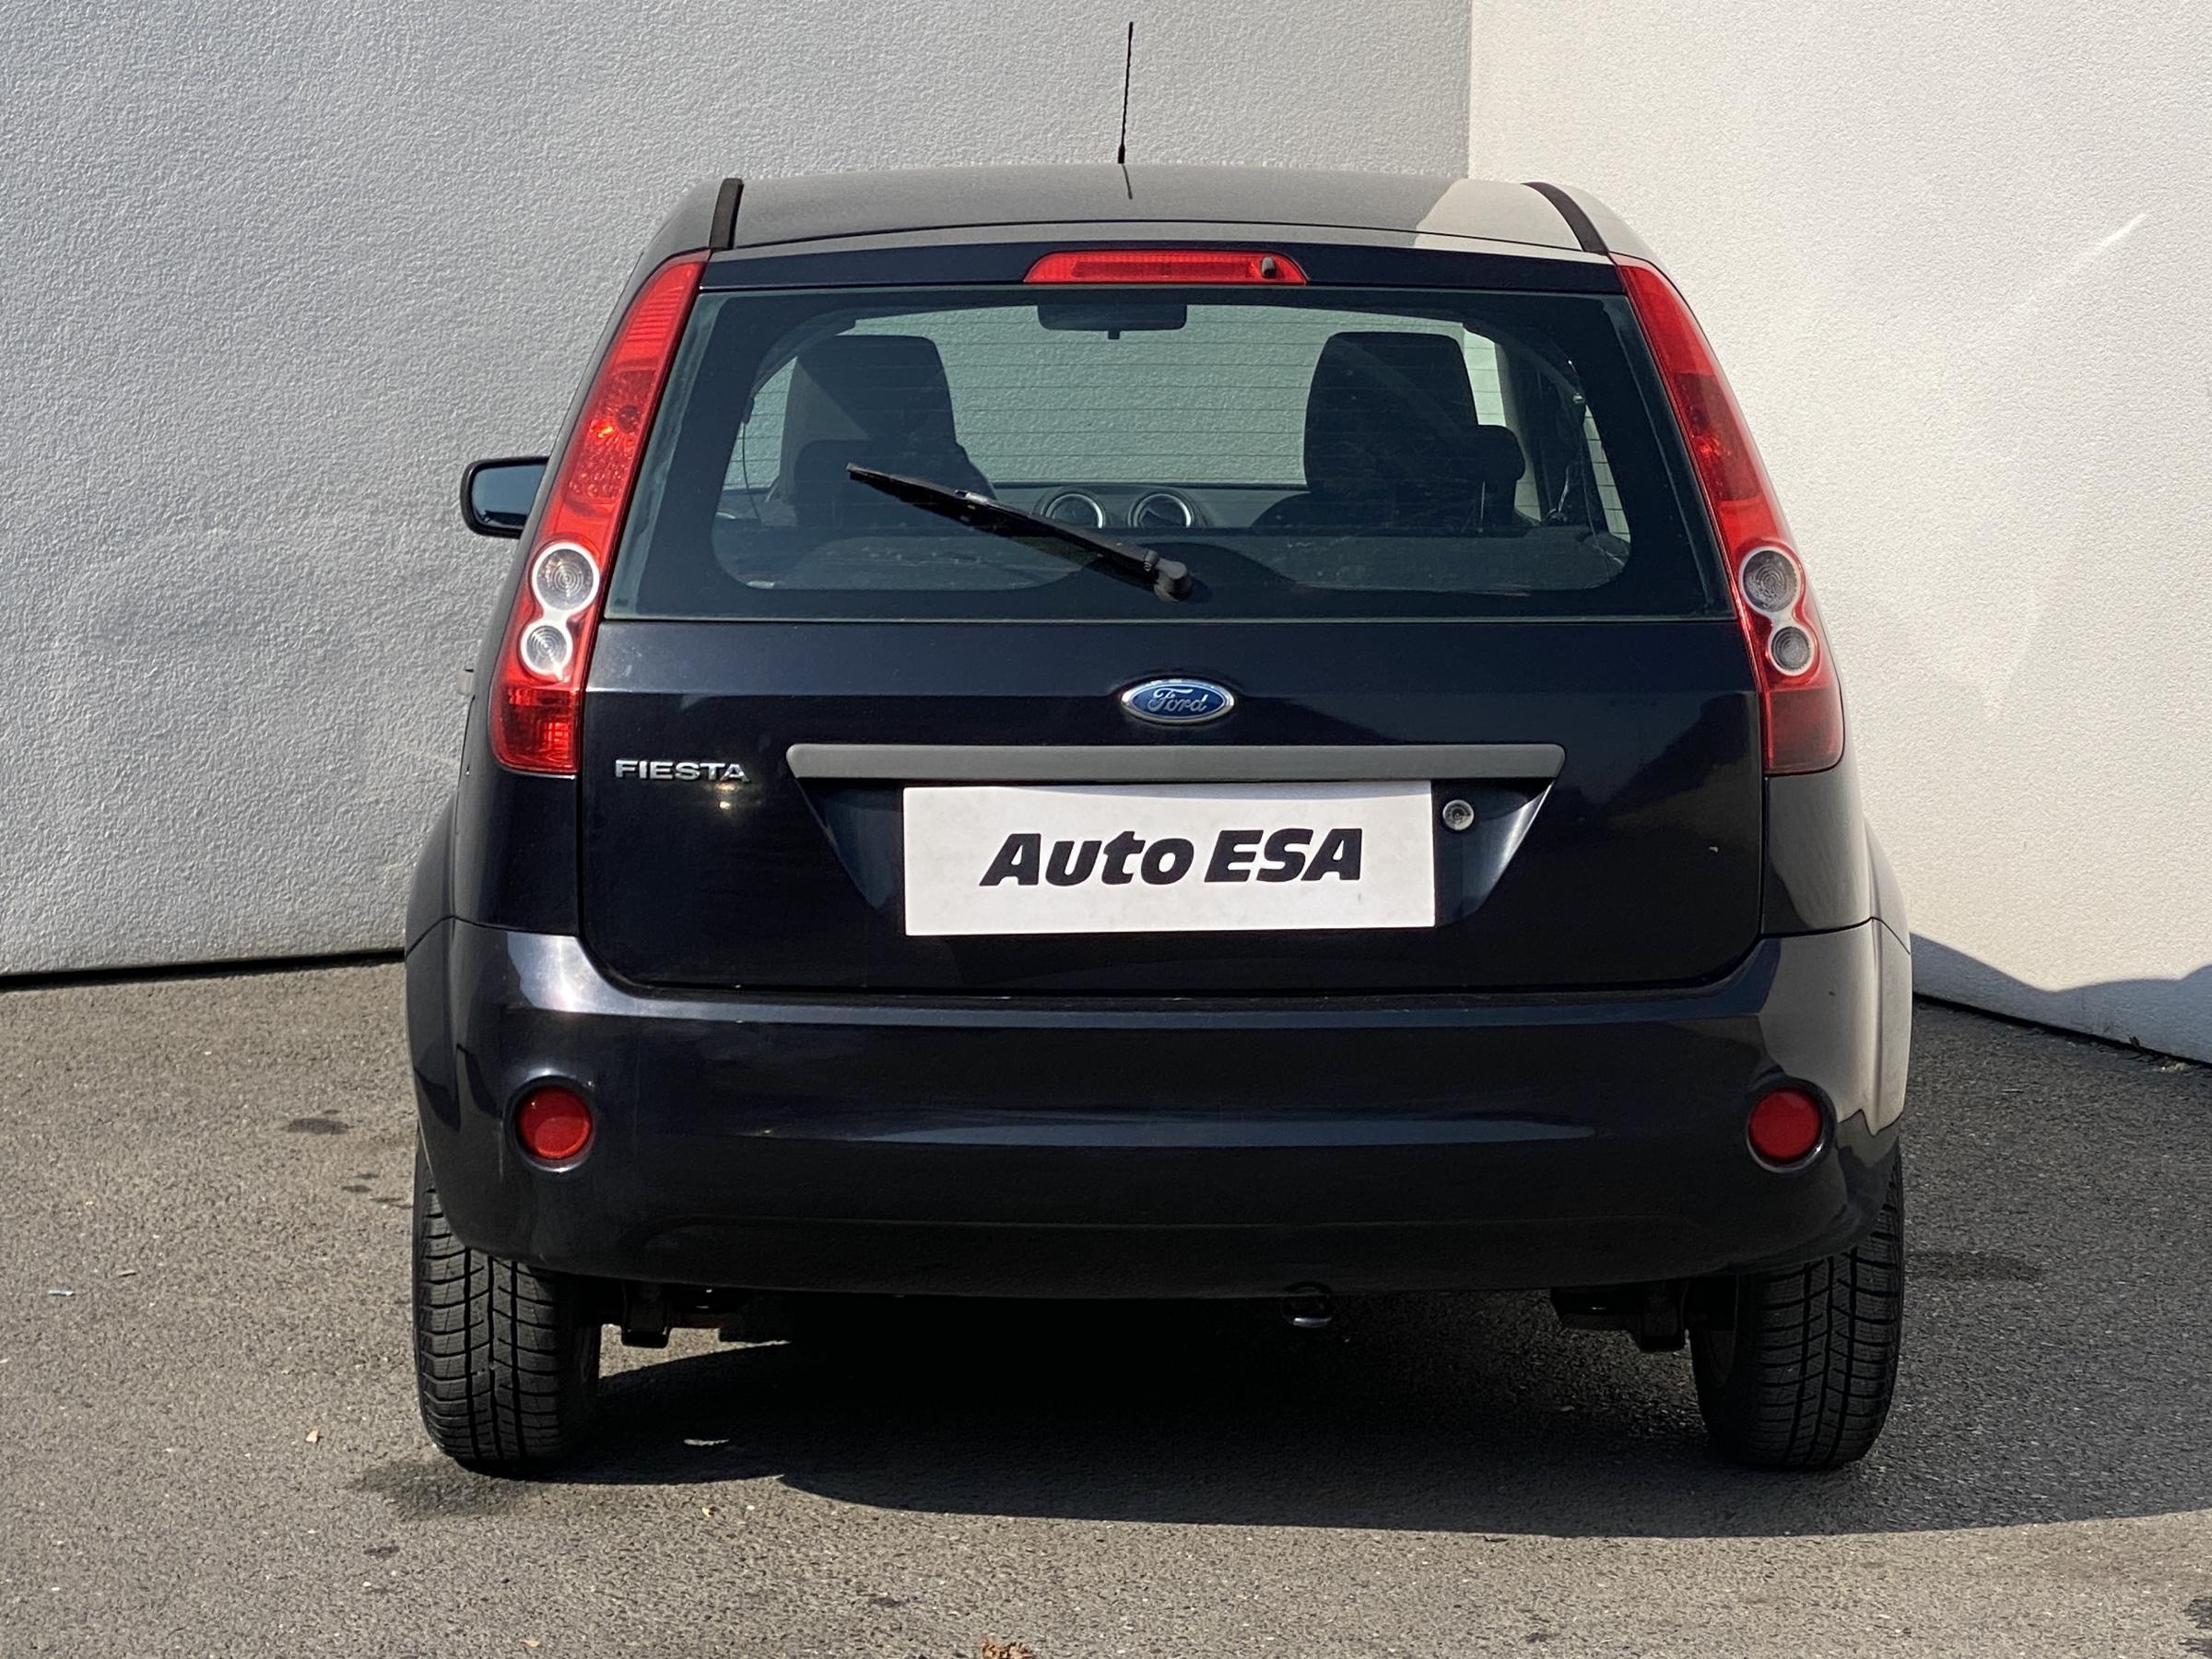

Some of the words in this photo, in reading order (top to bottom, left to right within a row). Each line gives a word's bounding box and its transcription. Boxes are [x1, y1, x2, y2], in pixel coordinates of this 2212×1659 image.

[1147, 688, 1208, 712] Ford
[615, 759, 749, 782] FIESTA
[979, 830, 1194, 886] Auto
[1204, 828, 1362, 883] ESA
